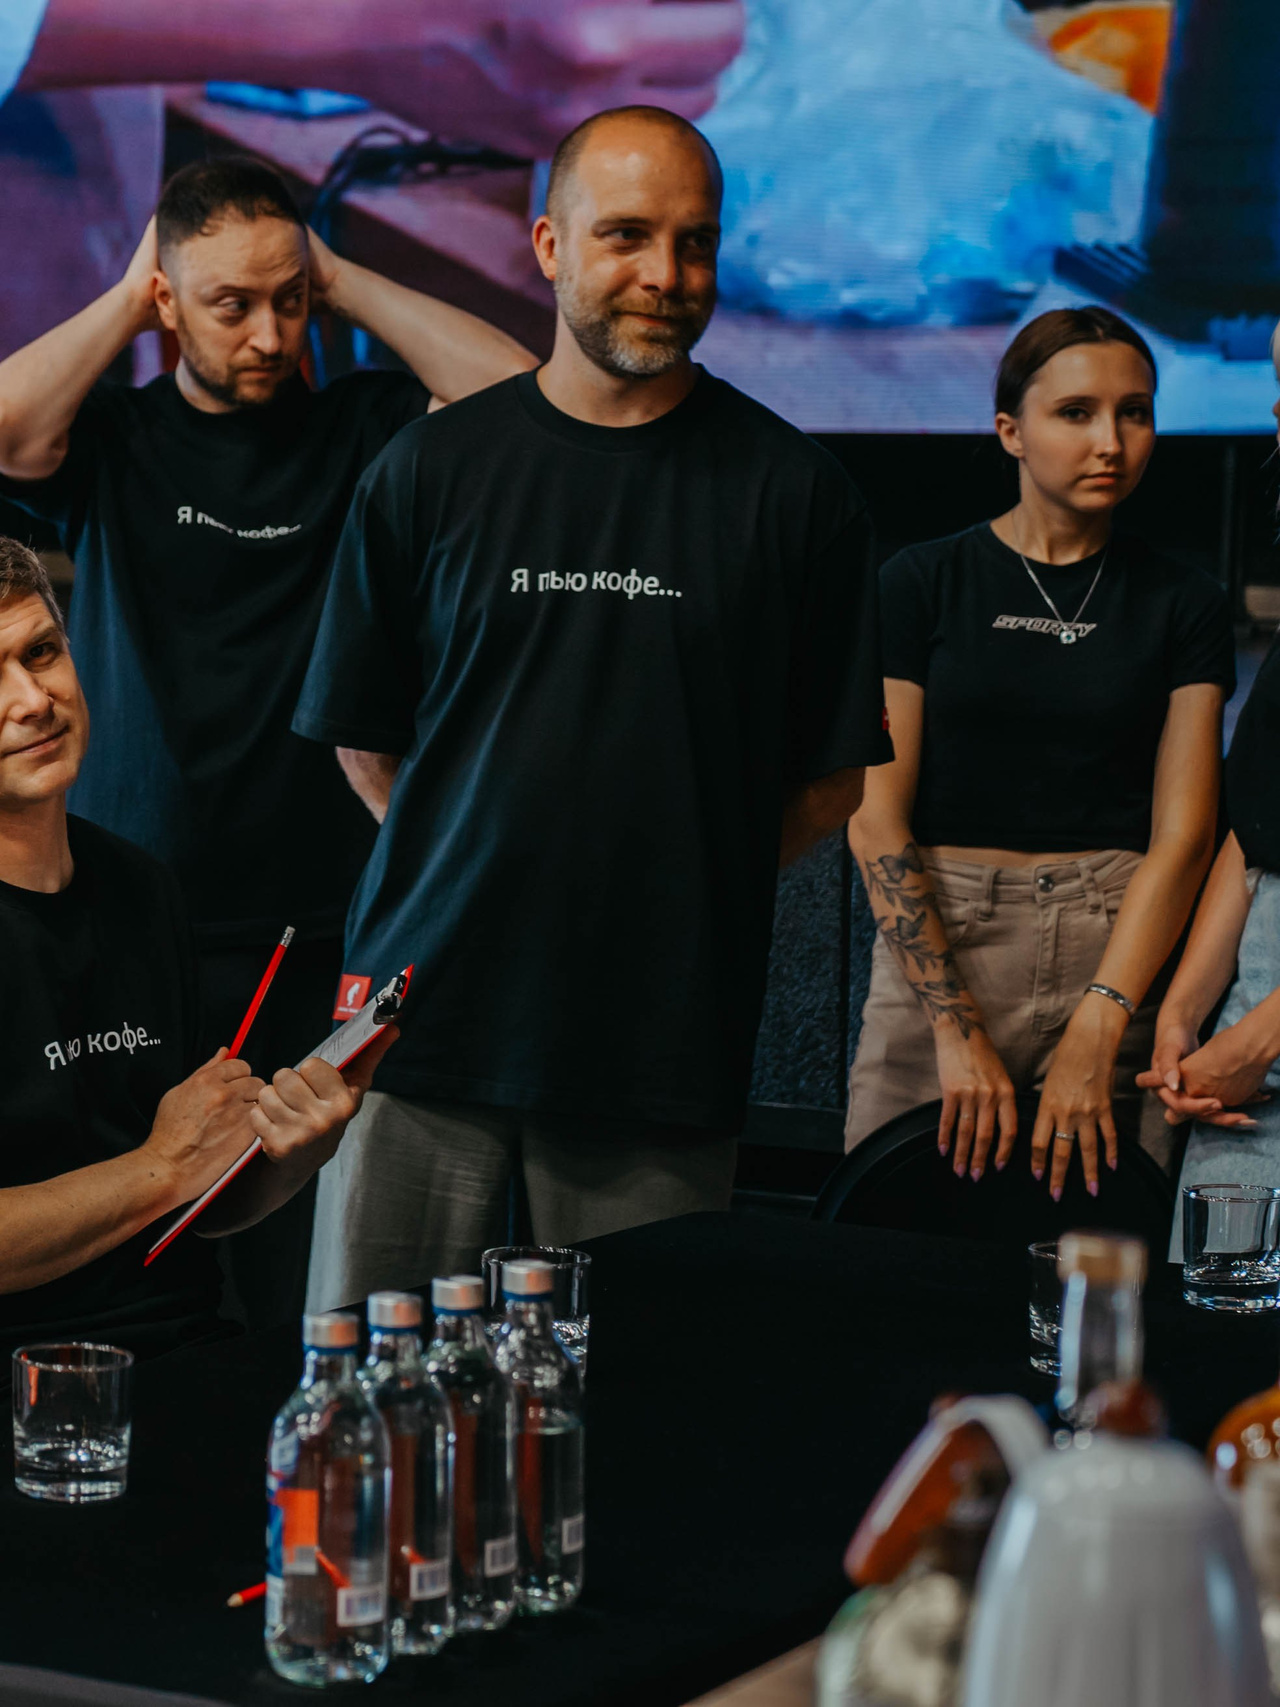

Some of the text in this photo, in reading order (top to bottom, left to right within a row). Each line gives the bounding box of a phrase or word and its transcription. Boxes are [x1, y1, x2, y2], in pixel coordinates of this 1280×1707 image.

[177, 506, 192, 524] Я
[510, 568, 682, 600] Я пью кофе...
[44, 1041, 67, 1070] Я
[87, 1021, 161, 1055] кофе...
